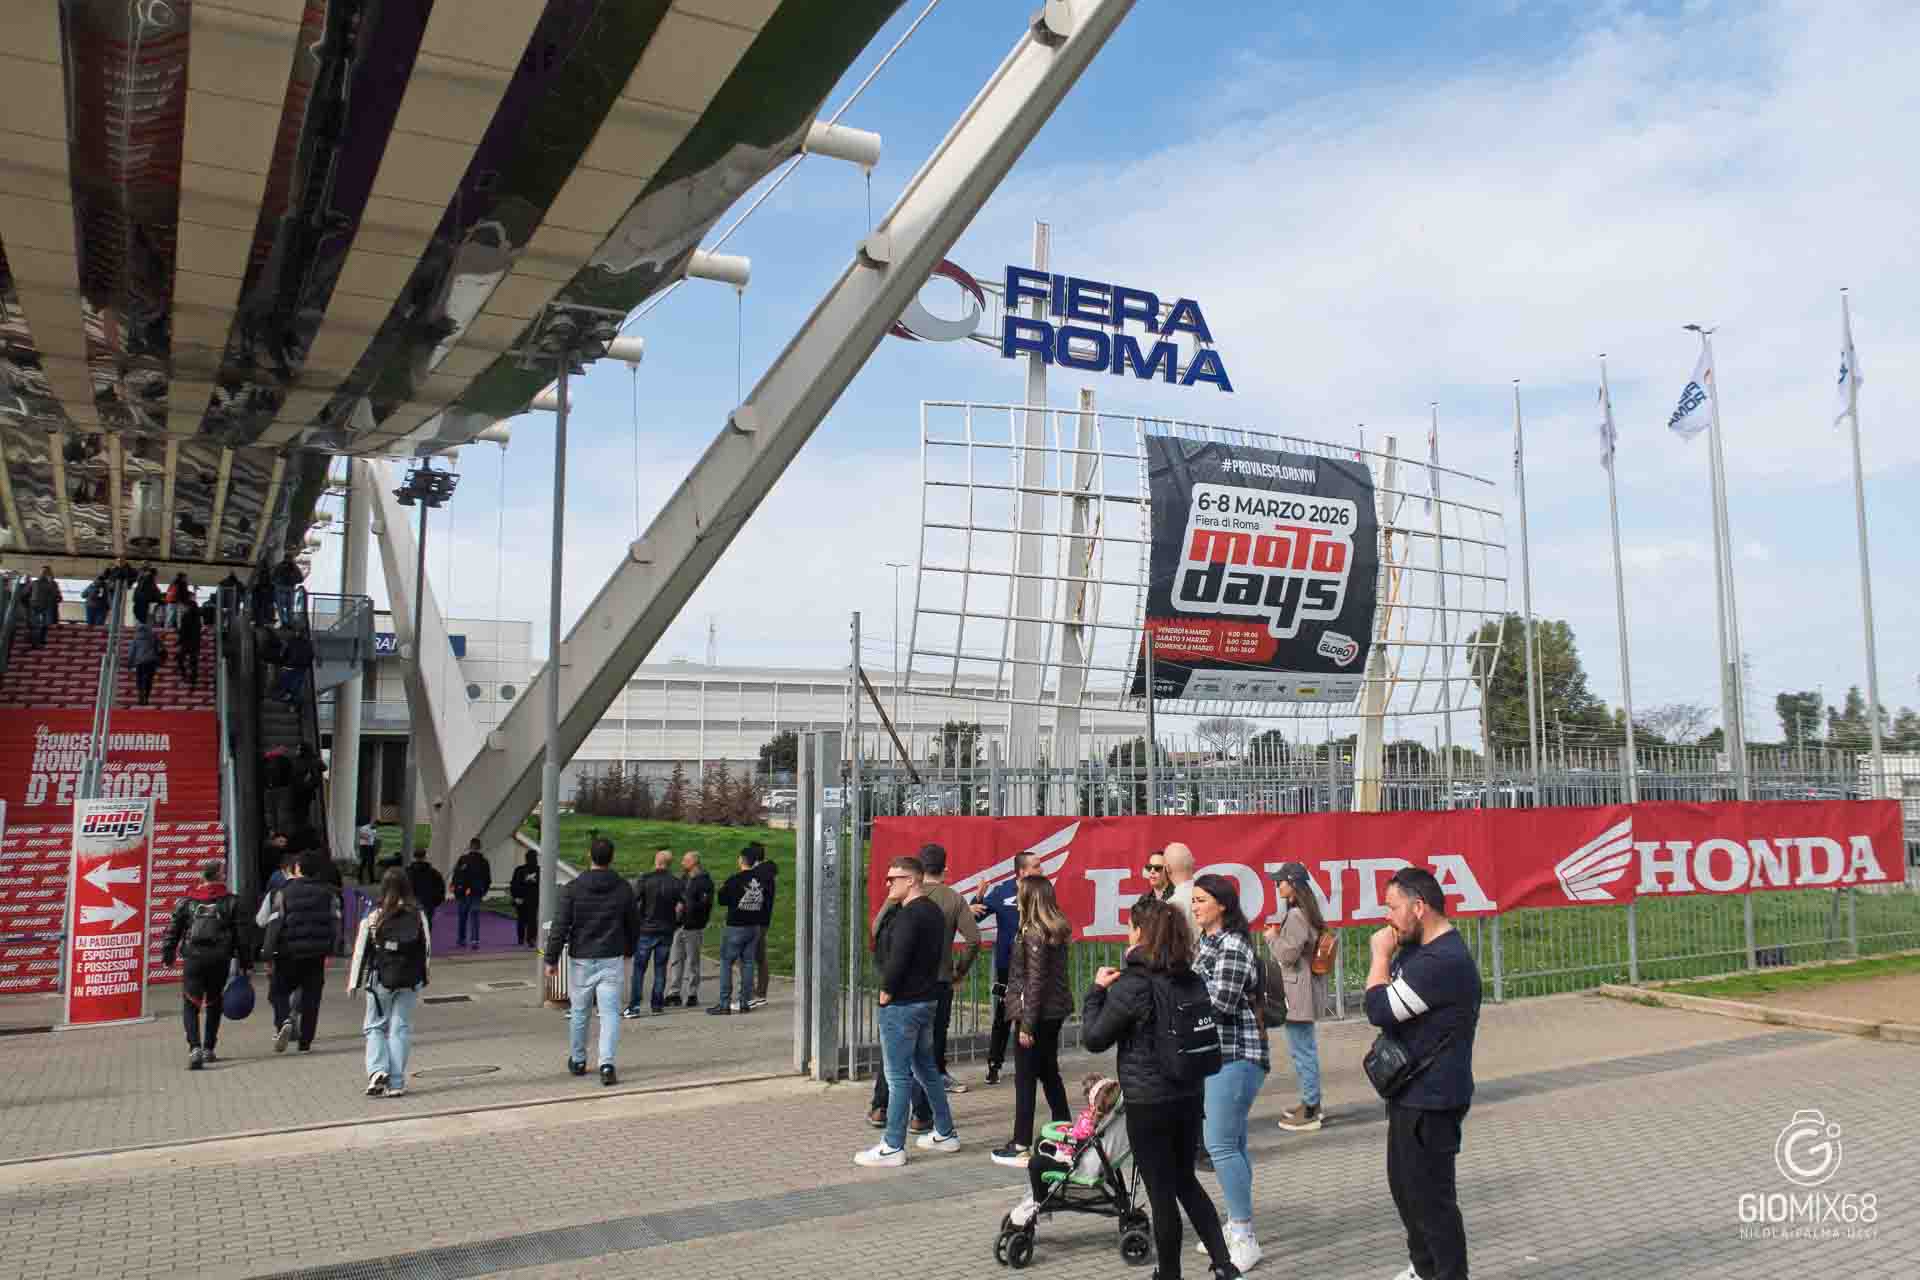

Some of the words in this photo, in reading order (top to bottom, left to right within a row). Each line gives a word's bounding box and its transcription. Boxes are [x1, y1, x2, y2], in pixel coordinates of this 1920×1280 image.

[1005, 264, 1213, 343] FIERA
[1001, 315, 1234, 392] ROMA
[1221, 457, 1317, 484] #PROVAESPLORAVIVI
[1195, 514, 1219, 527] Fiera
[1221, 516, 1231, 528] di
[1232, 518, 1260, 531] Roma
[1197, 492, 1231, 512] 6-8
[1234, 496, 1305, 520] MARZO
[1307, 505, 1351, 526] 2026
[1179, 561, 1340, 629] days
[1320, 643, 1349, 657] GLOBO
[36, 733, 170, 751] CONCEIONARIA
[32, 750, 87, 771] HOND
[24, 773, 168, 806] D'EROPA
[1633, 835, 1886, 894] HONDA
[89, 934, 139, 947] PADIGLIONI
[77, 962, 83, 973] E
